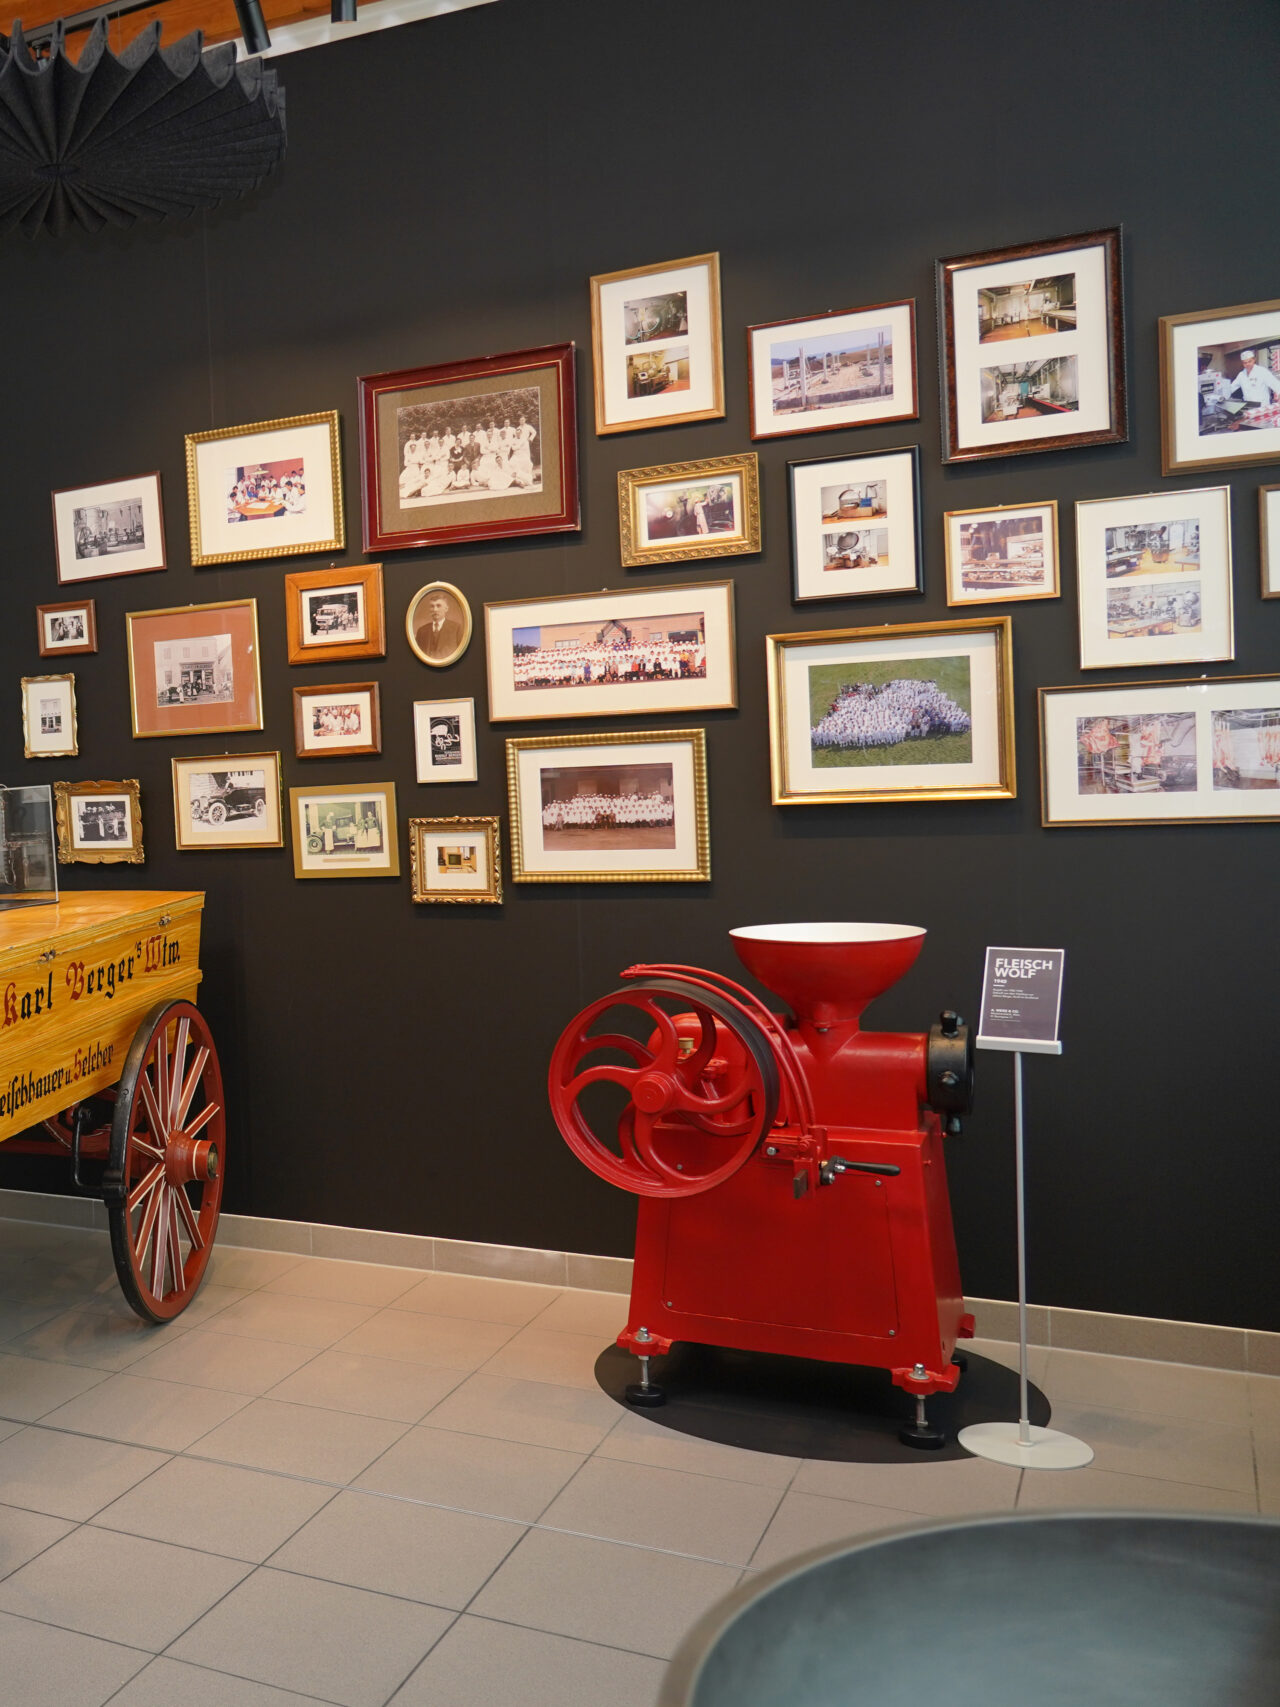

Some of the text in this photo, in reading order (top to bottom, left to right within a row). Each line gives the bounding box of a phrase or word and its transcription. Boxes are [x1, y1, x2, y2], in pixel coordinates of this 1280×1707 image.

[995, 958, 1053, 970] FLEISCH
[994, 967, 1037, 979] WOLF
[1, 971, 53, 1029] Karl
